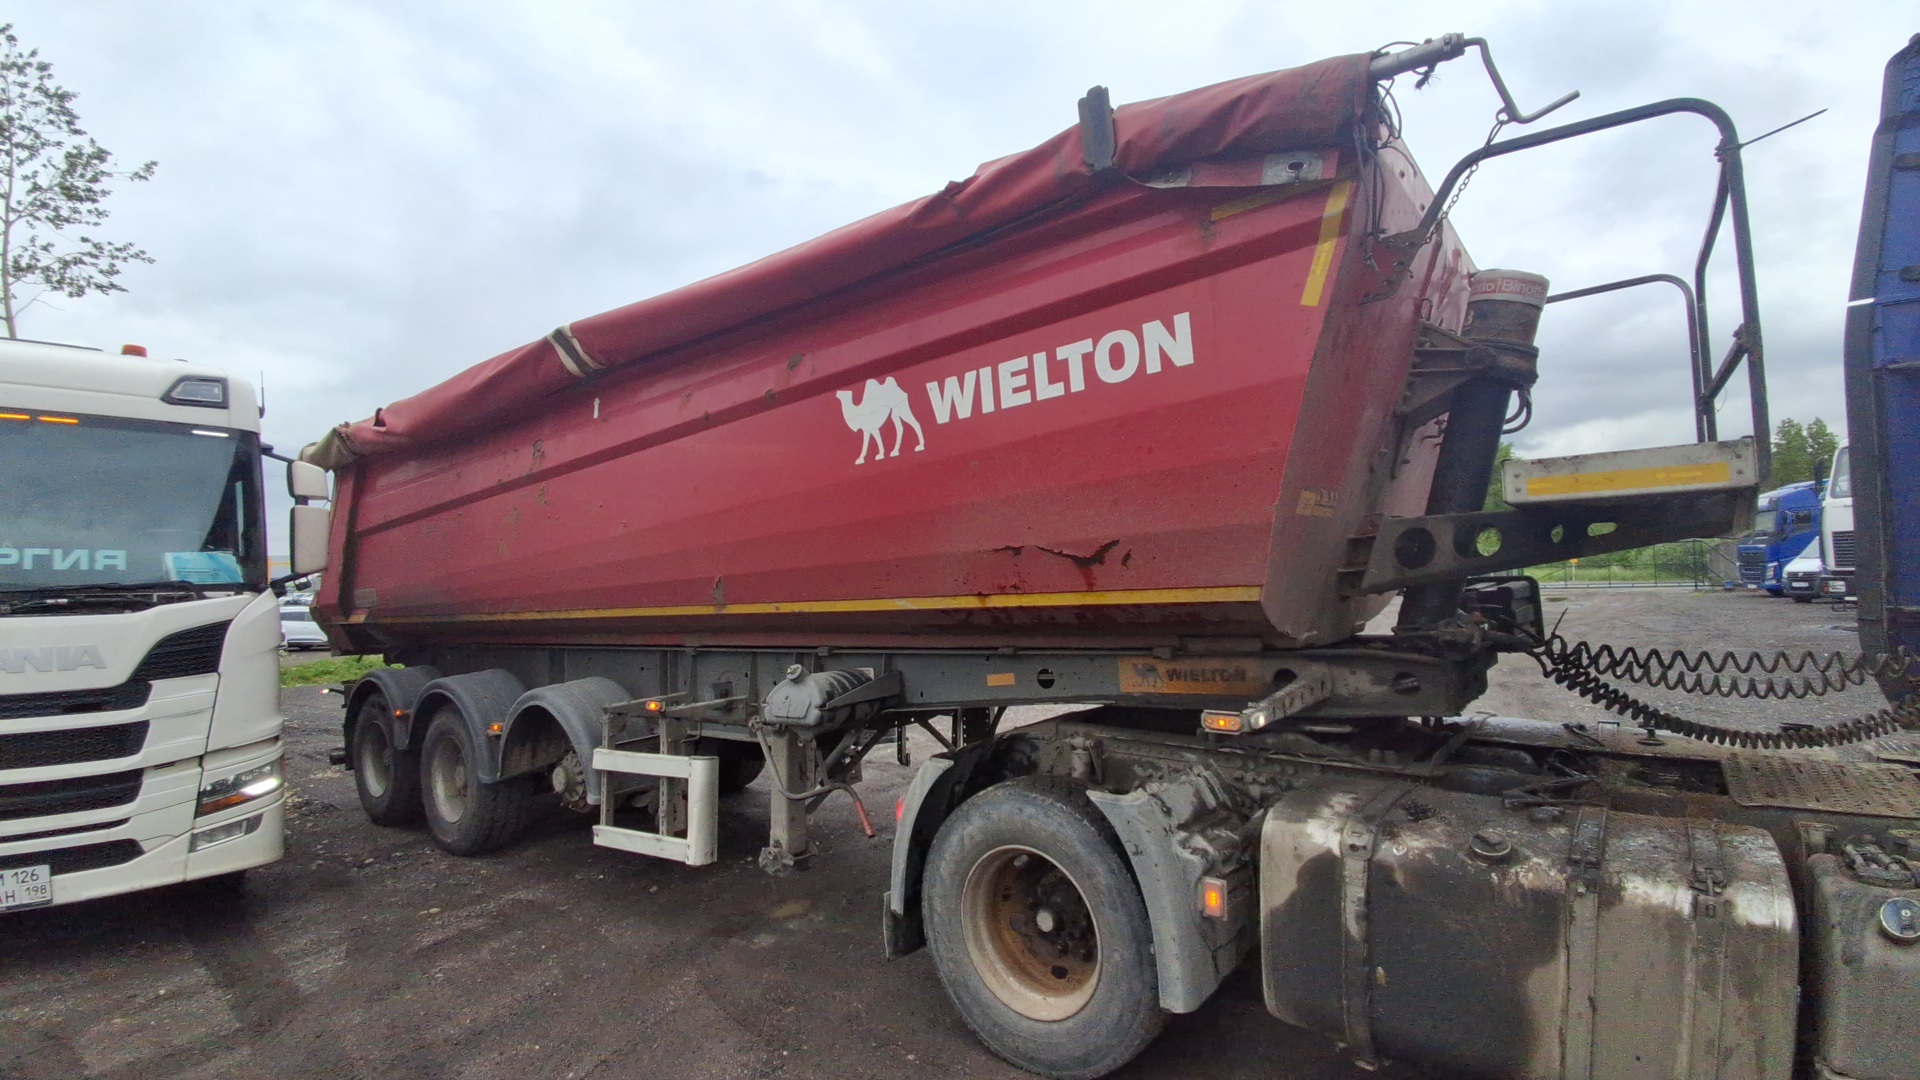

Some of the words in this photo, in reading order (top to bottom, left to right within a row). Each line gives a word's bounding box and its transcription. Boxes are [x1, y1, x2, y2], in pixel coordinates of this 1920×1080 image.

[926, 311, 1194, 424] WIELTON
[1165, 668, 1247, 682] WIELTON
[10, 868, 40, 885] 126
[0, 889, 16, 904] Н
[24, 884, 48, 897] 198
